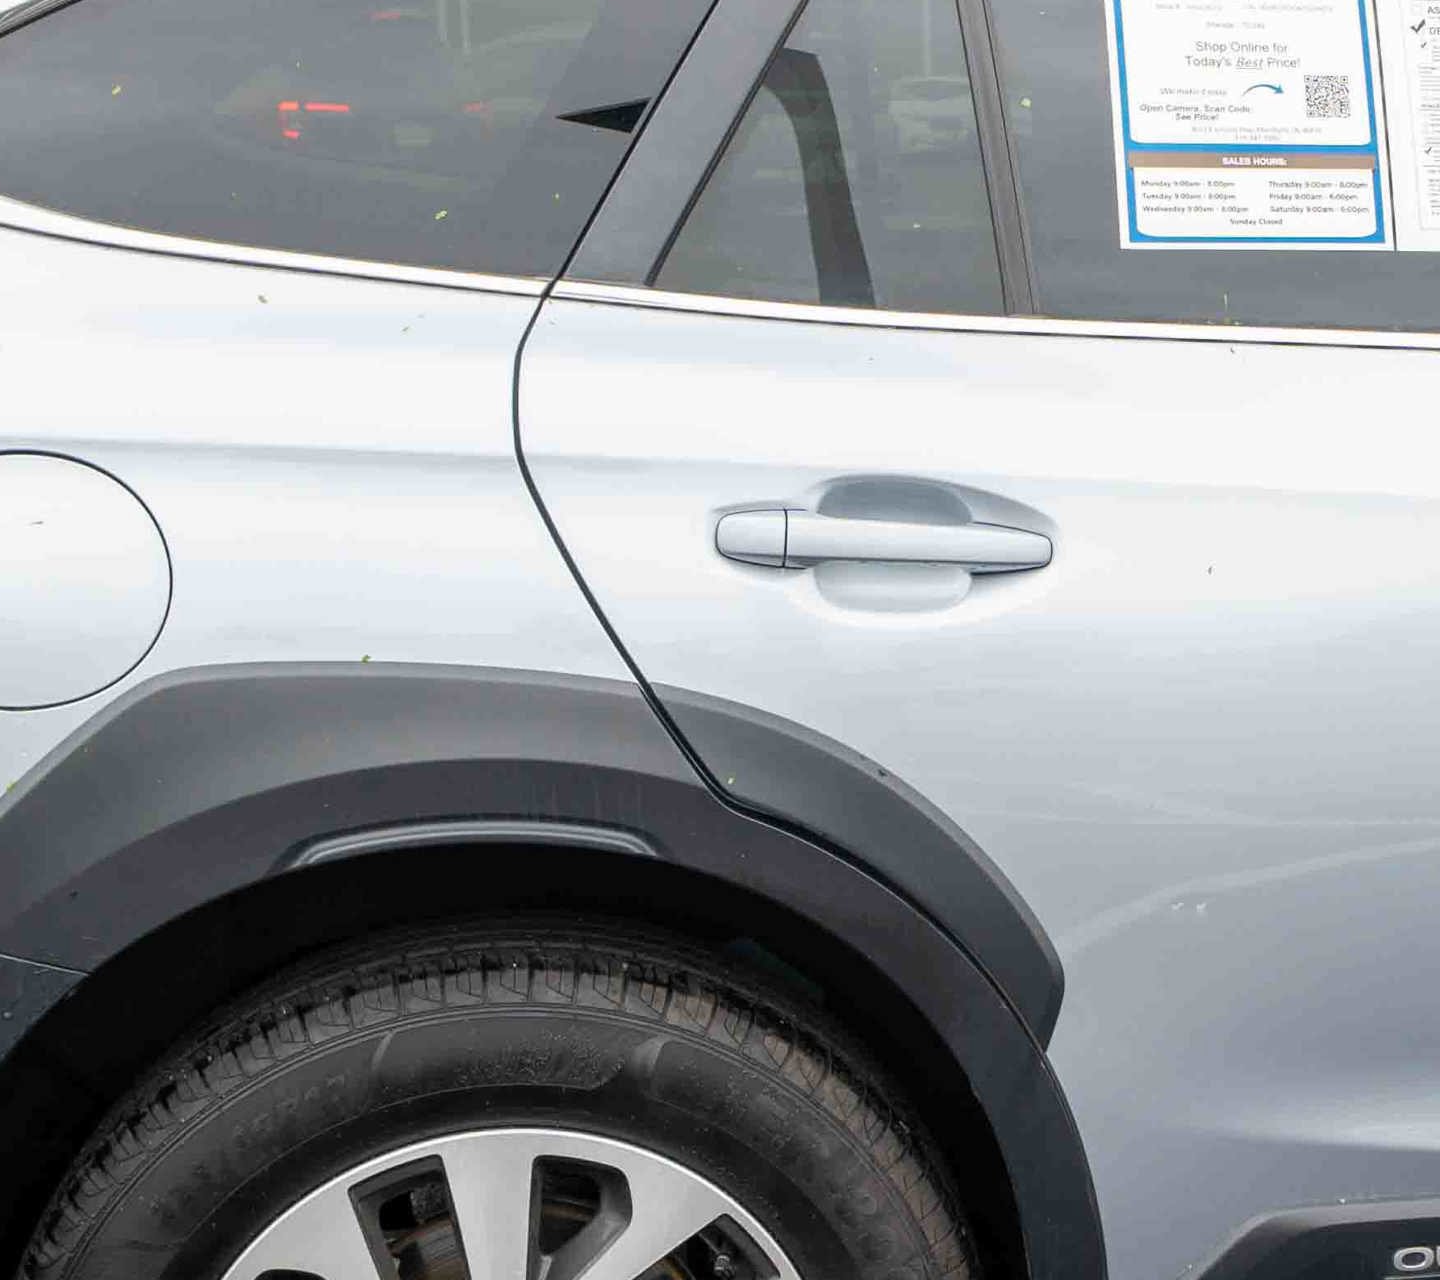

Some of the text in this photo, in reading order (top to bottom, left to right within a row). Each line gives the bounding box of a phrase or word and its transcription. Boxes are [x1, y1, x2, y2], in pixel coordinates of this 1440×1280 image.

[1427, 6, 1440, 15] AS
[1195, 41, 1287, 53] Shop Online for
[1185, 55, 1301, 69] Today's Best Price!
[1222, 157, 1251, 166] SALES
